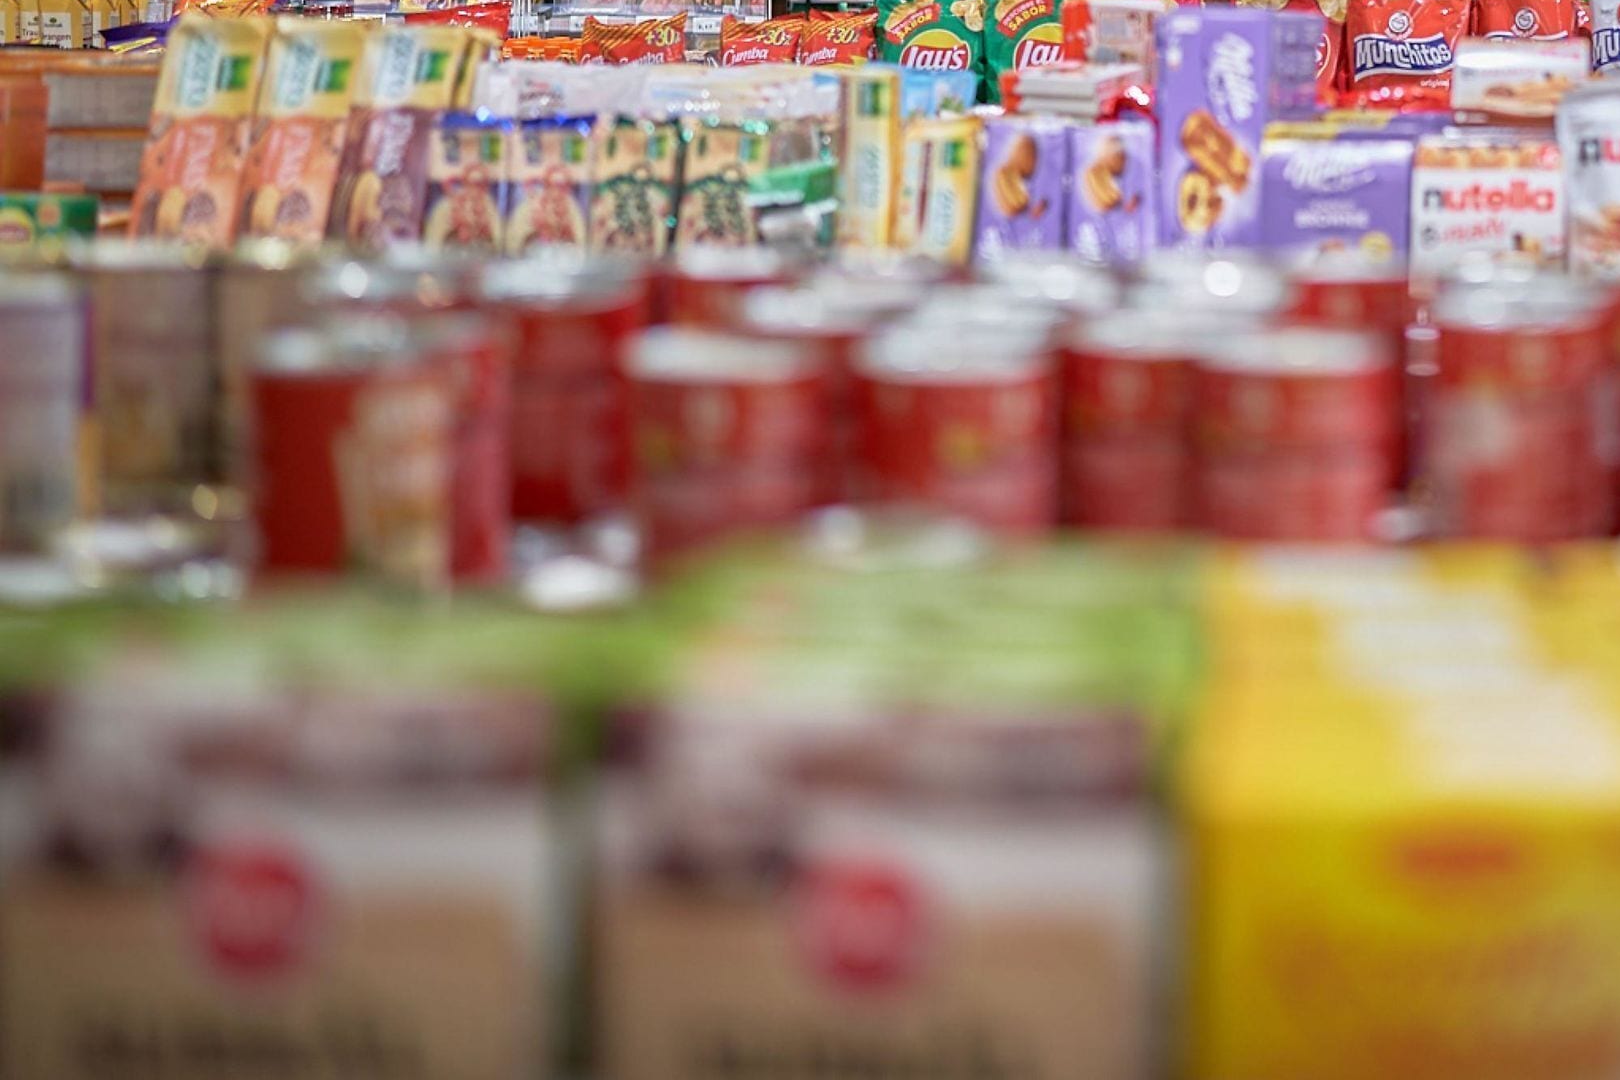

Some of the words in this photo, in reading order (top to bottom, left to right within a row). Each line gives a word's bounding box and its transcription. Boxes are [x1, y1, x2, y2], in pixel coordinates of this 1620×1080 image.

[1008, 4, 1047, 32] SABOR
[905, 45, 967, 71] Lay's
[1355, 38, 1453, 69] Munchitos
[1422, 179, 1556, 213] nutella
